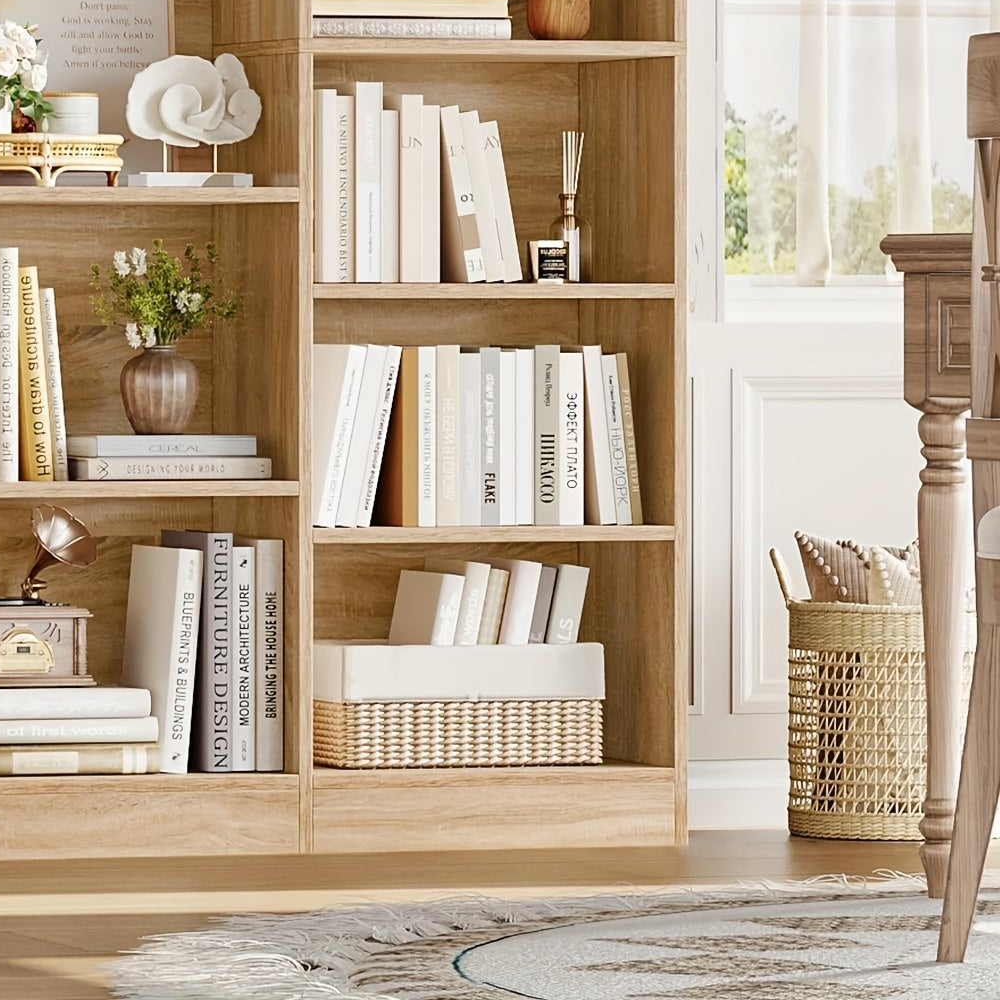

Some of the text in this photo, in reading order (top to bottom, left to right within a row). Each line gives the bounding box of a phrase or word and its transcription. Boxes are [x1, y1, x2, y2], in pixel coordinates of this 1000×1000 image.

[62, 16, 81, 25] God
[79, 30, 95, 39] and
[97, 30, 120, 39] allow
[123, 30, 143, 40] God
[145, 30, 154, 40] to
[63, 60, 117, 70] Amen you
[339, 177, 347, 248] INCENDIARIO
[127, 465, 226, 475] DESIGNING YOUR WORLD
[540, 434, 555, 504] ПИКАССО
[566, 392, 578, 489] ЭФФЕКТ ПЛАТО
[609, 427, 628, 505] НЬЮ-ЙОРК
[484, 472, 496, 504] FLAKE
[171, 592, 195, 741] BLUEPRINTS & BUILDINGS
[213, 538, 228, 769] FURNITURE DESIGN
[239, 584, 250, 727] MODERN ARCHITECTURE
[265, 591, 277, 719] BRINGING THE HOUSE HOME
[7, 725, 26, 738] of
[31, 725, 65, 738] first
[70, 725, 127, 738] words
